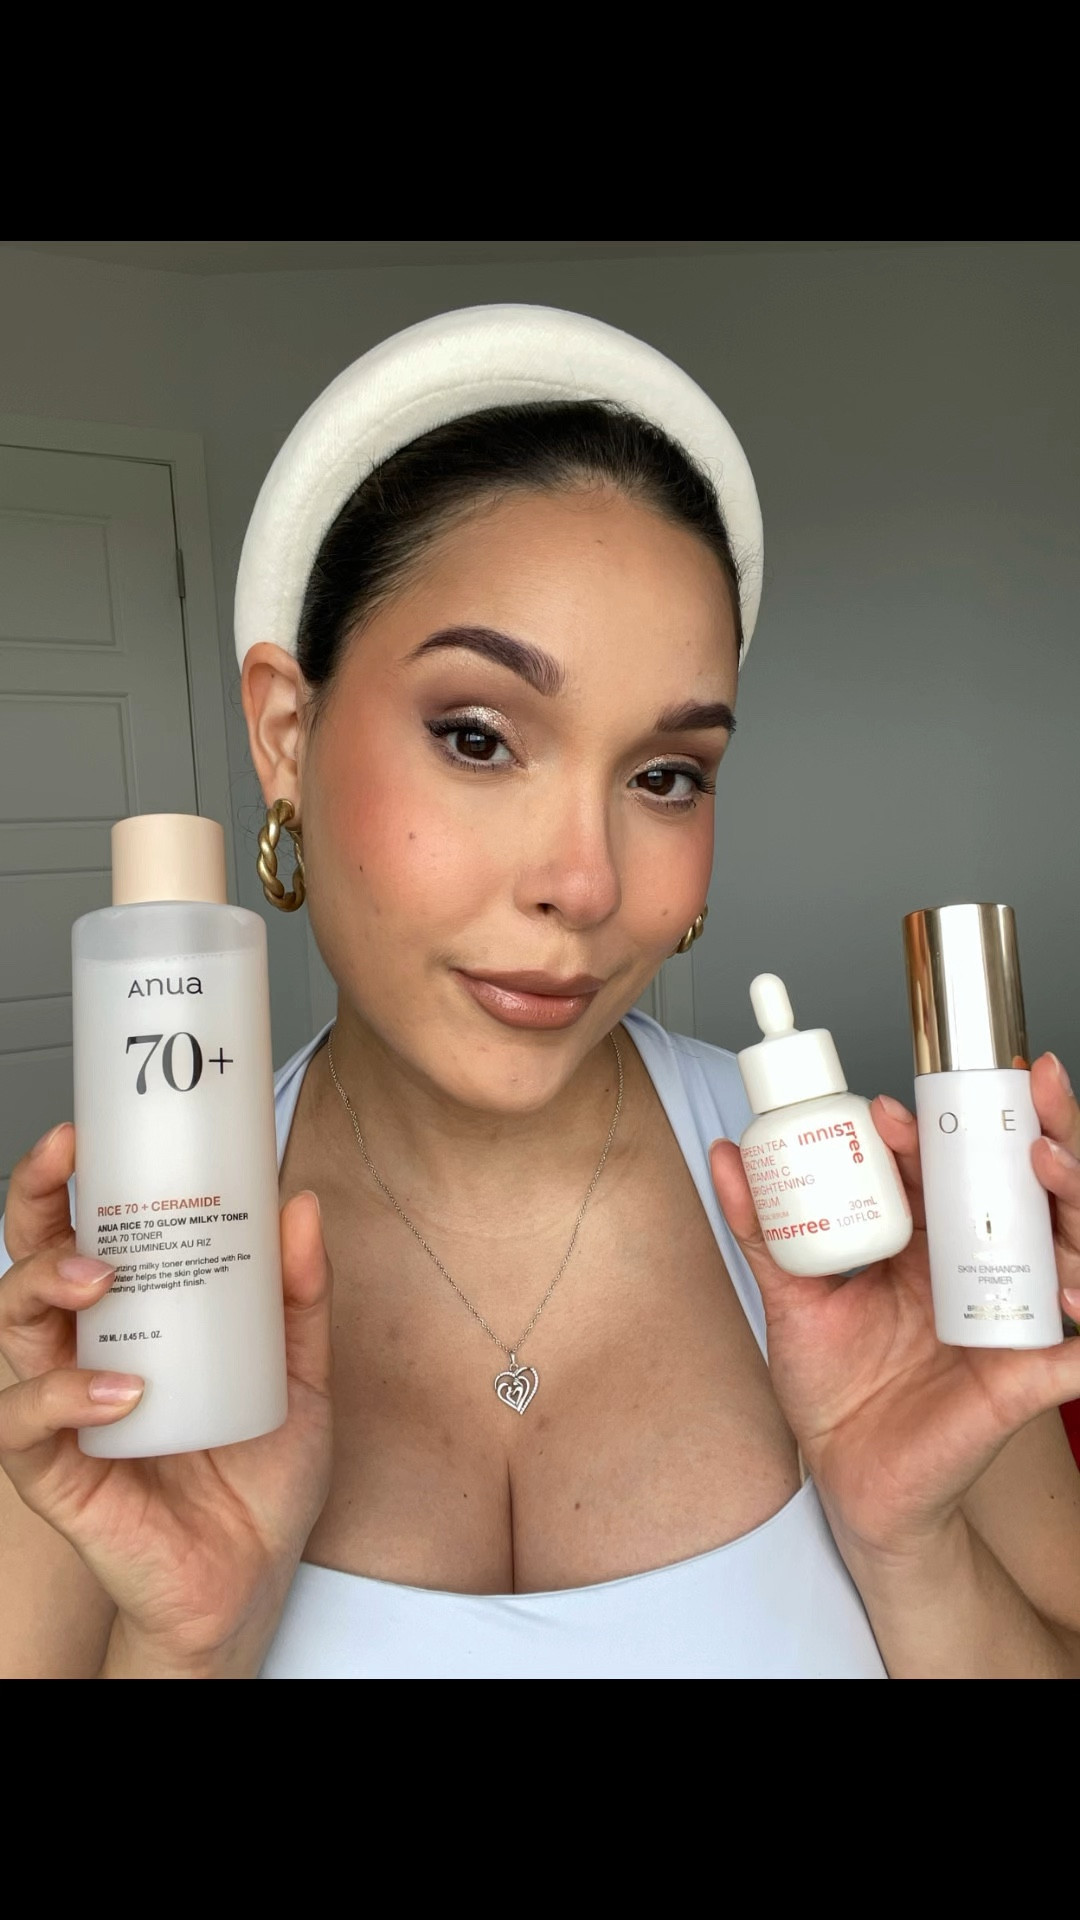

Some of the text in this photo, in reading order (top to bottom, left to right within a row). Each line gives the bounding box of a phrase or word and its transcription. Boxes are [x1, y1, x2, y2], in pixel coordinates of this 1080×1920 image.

[128, 976, 203, 998] Anua
[126, 1032, 233, 1095] 70+
[766, 1138, 788, 1153] TEA
[781, 1166, 791, 1177] C
[97, 1205, 122, 1217] RICE
[125, 1203, 138, 1214] 70
[151, 1196, 221, 1212] CERAMIDE
[97, 1212, 249, 1233] ANUA RICE 70 GLOW MILKY TONER
[97, 1231, 163, 1244] ANUA 70 TONER
[97, 1238, 212, 1256] LAITEUX LUMINEUX AU RIZ
[139, 1262, 160, 1271] milky
[162, 1260, 183, 1268] toner
[185, 1255, 219, 1266] enriched
[221, 1254, 236, 1262] with
[237, 1253, 251, 1261] Rice
[957, 1264, 1031, 1274] SKIN ENHANCING
[135, 1272, 157, 1282] helps
[159, 1271, 172, 1279] the
[174, 1270, 191, 1278] skin
[193, 1267, 212, 1277] glow
[214, 1265, 229, 1273] with
[978, 1276, 1013, 1285] PRIMER
[137, 1279, 181, 1292] lightweight
[183, 1277, 207, 1287] finish.
[109, 1334, 119, 1342] ML
[123, 1332, 137, 1341] 8.45
